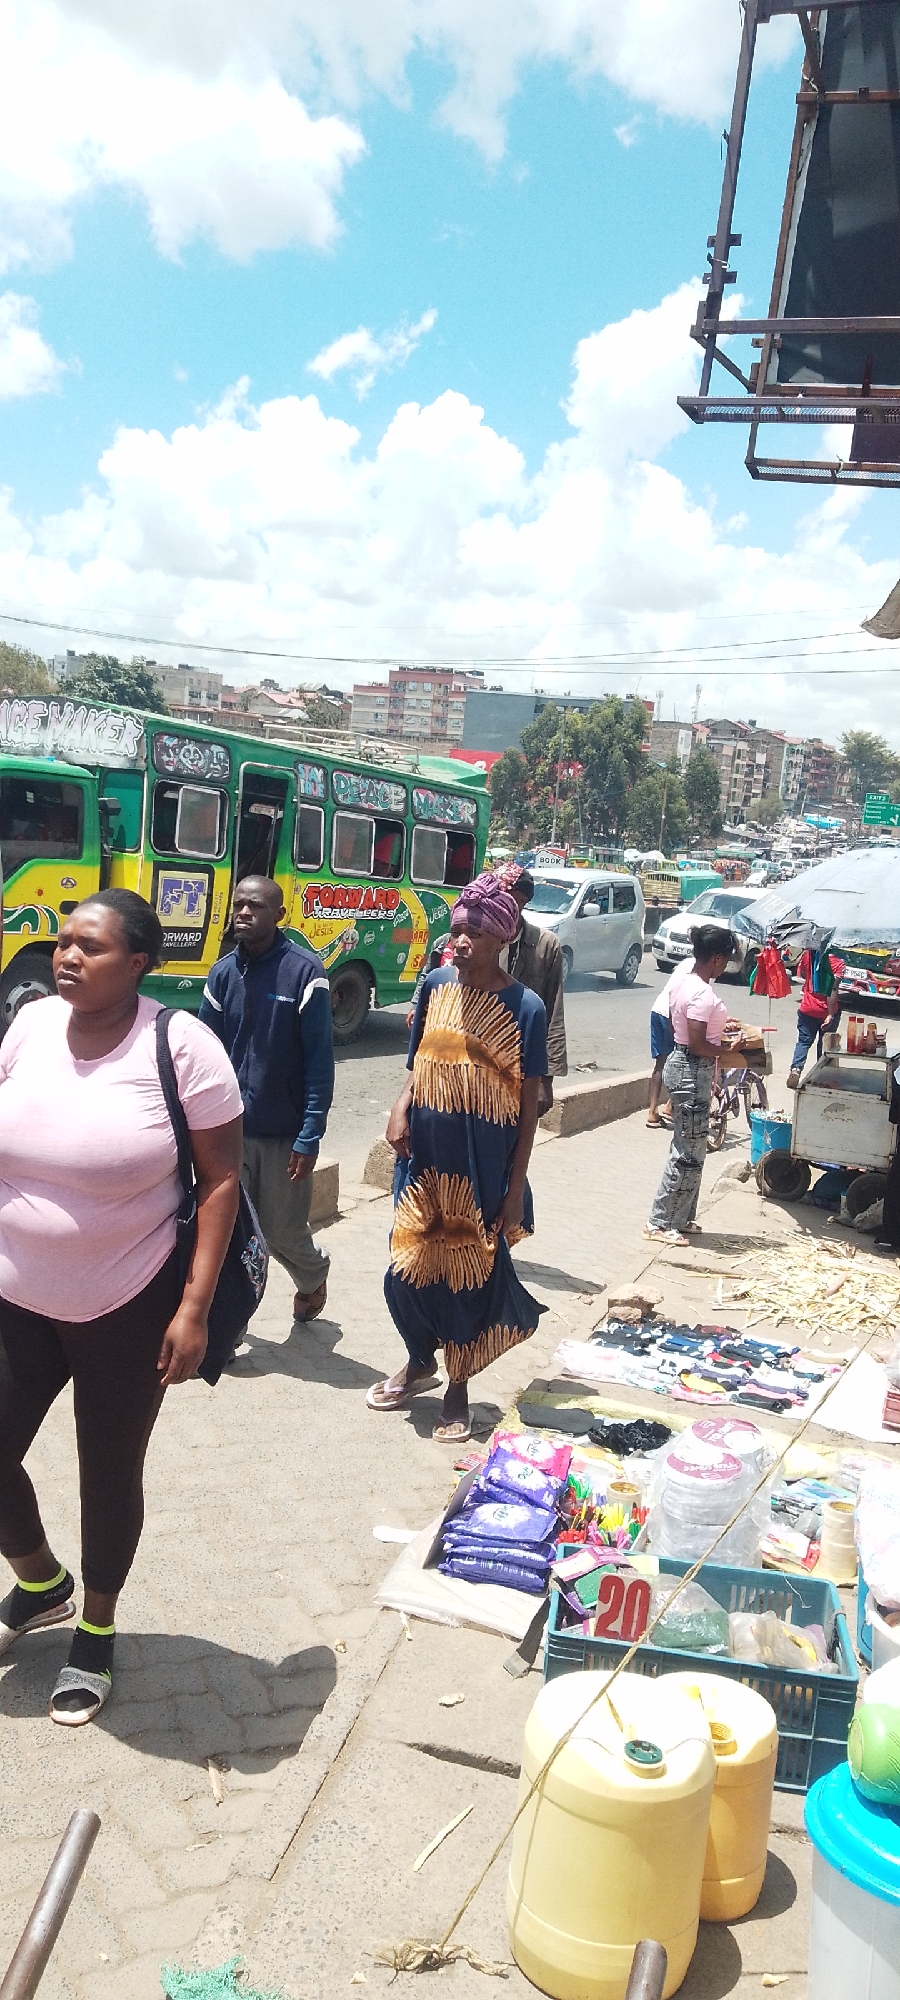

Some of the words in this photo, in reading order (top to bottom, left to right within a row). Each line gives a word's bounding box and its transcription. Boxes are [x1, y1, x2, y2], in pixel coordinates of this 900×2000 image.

[44, 701, 143, 757] MAKER
[297, 763, 324, 782] STAY
[299, 778, 325, 798] TRUE
[334, 773, 406, 811] PEACE
[415, 792, 477, 824] MAKER
[540, 857, 561, 865] BOOK
[159, 877, 206, 917] FT
[303, 883, 401, 917] FORWARD
[313, 908, 396, 919] TRAVELLERS
[163, 932, 202, 942] ORWARD
[594, 1575, 651, 1642] 20
